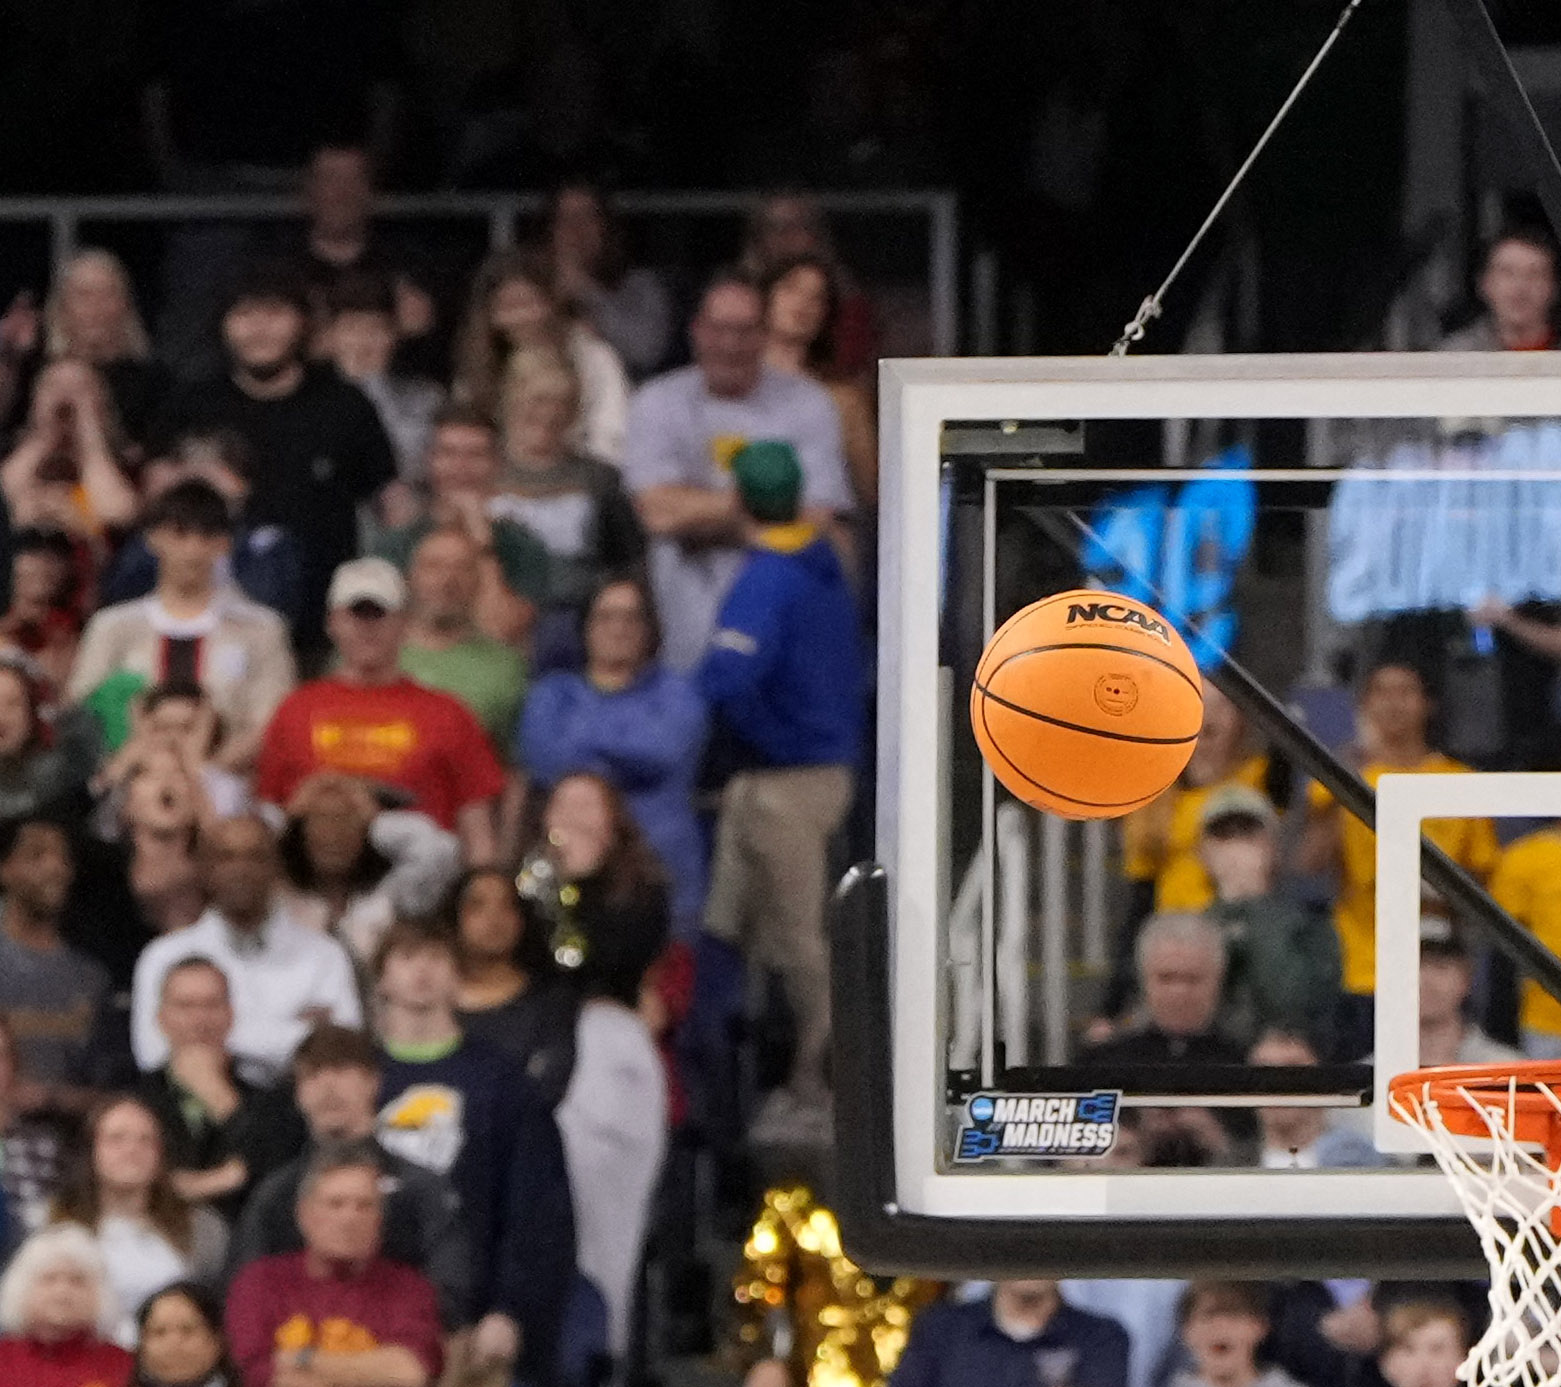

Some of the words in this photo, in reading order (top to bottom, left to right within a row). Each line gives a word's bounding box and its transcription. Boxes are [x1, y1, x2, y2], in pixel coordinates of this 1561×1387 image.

[1067, 602, 1171, 648] NCAA
[993, 1098, 1077, 1123] MARCH
[1002, 1123, 1114, 1148] MADNESS
